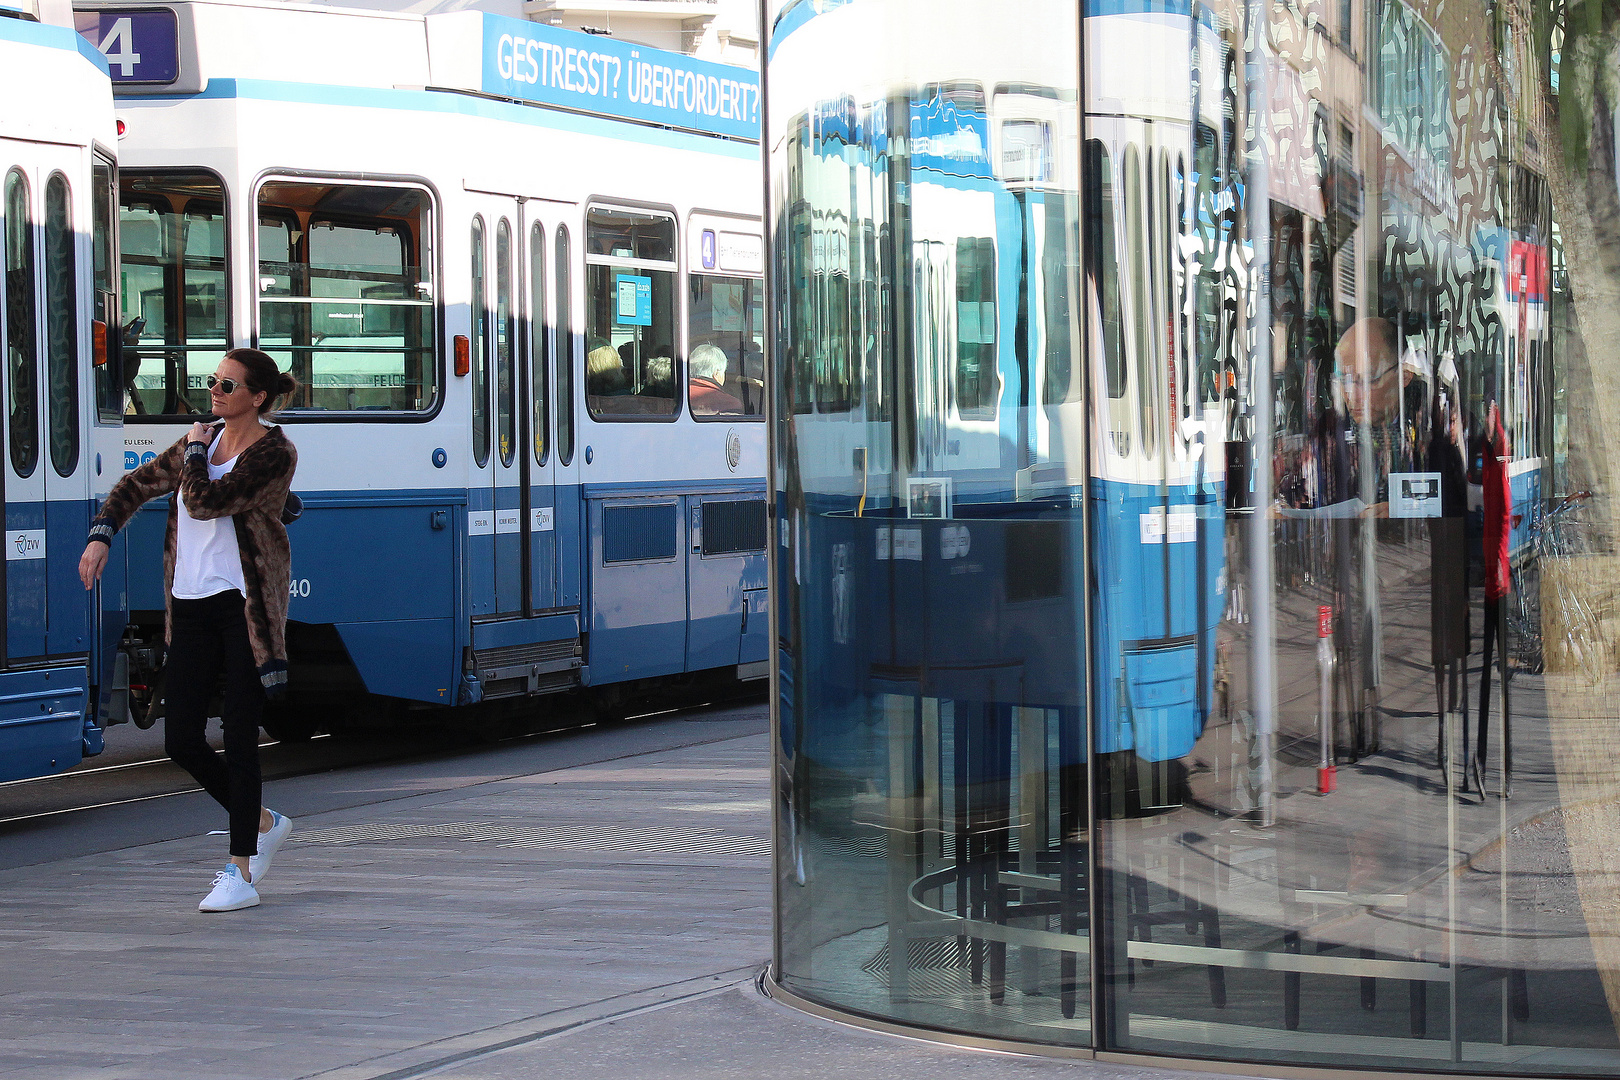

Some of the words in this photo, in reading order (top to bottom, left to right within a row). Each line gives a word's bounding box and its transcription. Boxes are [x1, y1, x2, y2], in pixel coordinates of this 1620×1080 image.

[98, 17, 141, 77] 4
[497, 33, 622, 99] GESTRESST?
[627, 51, 760, 124] ÜBERFORDERT?
[703, 235, 712, 263] 4
[27, 539, 40, 550] ZVV
